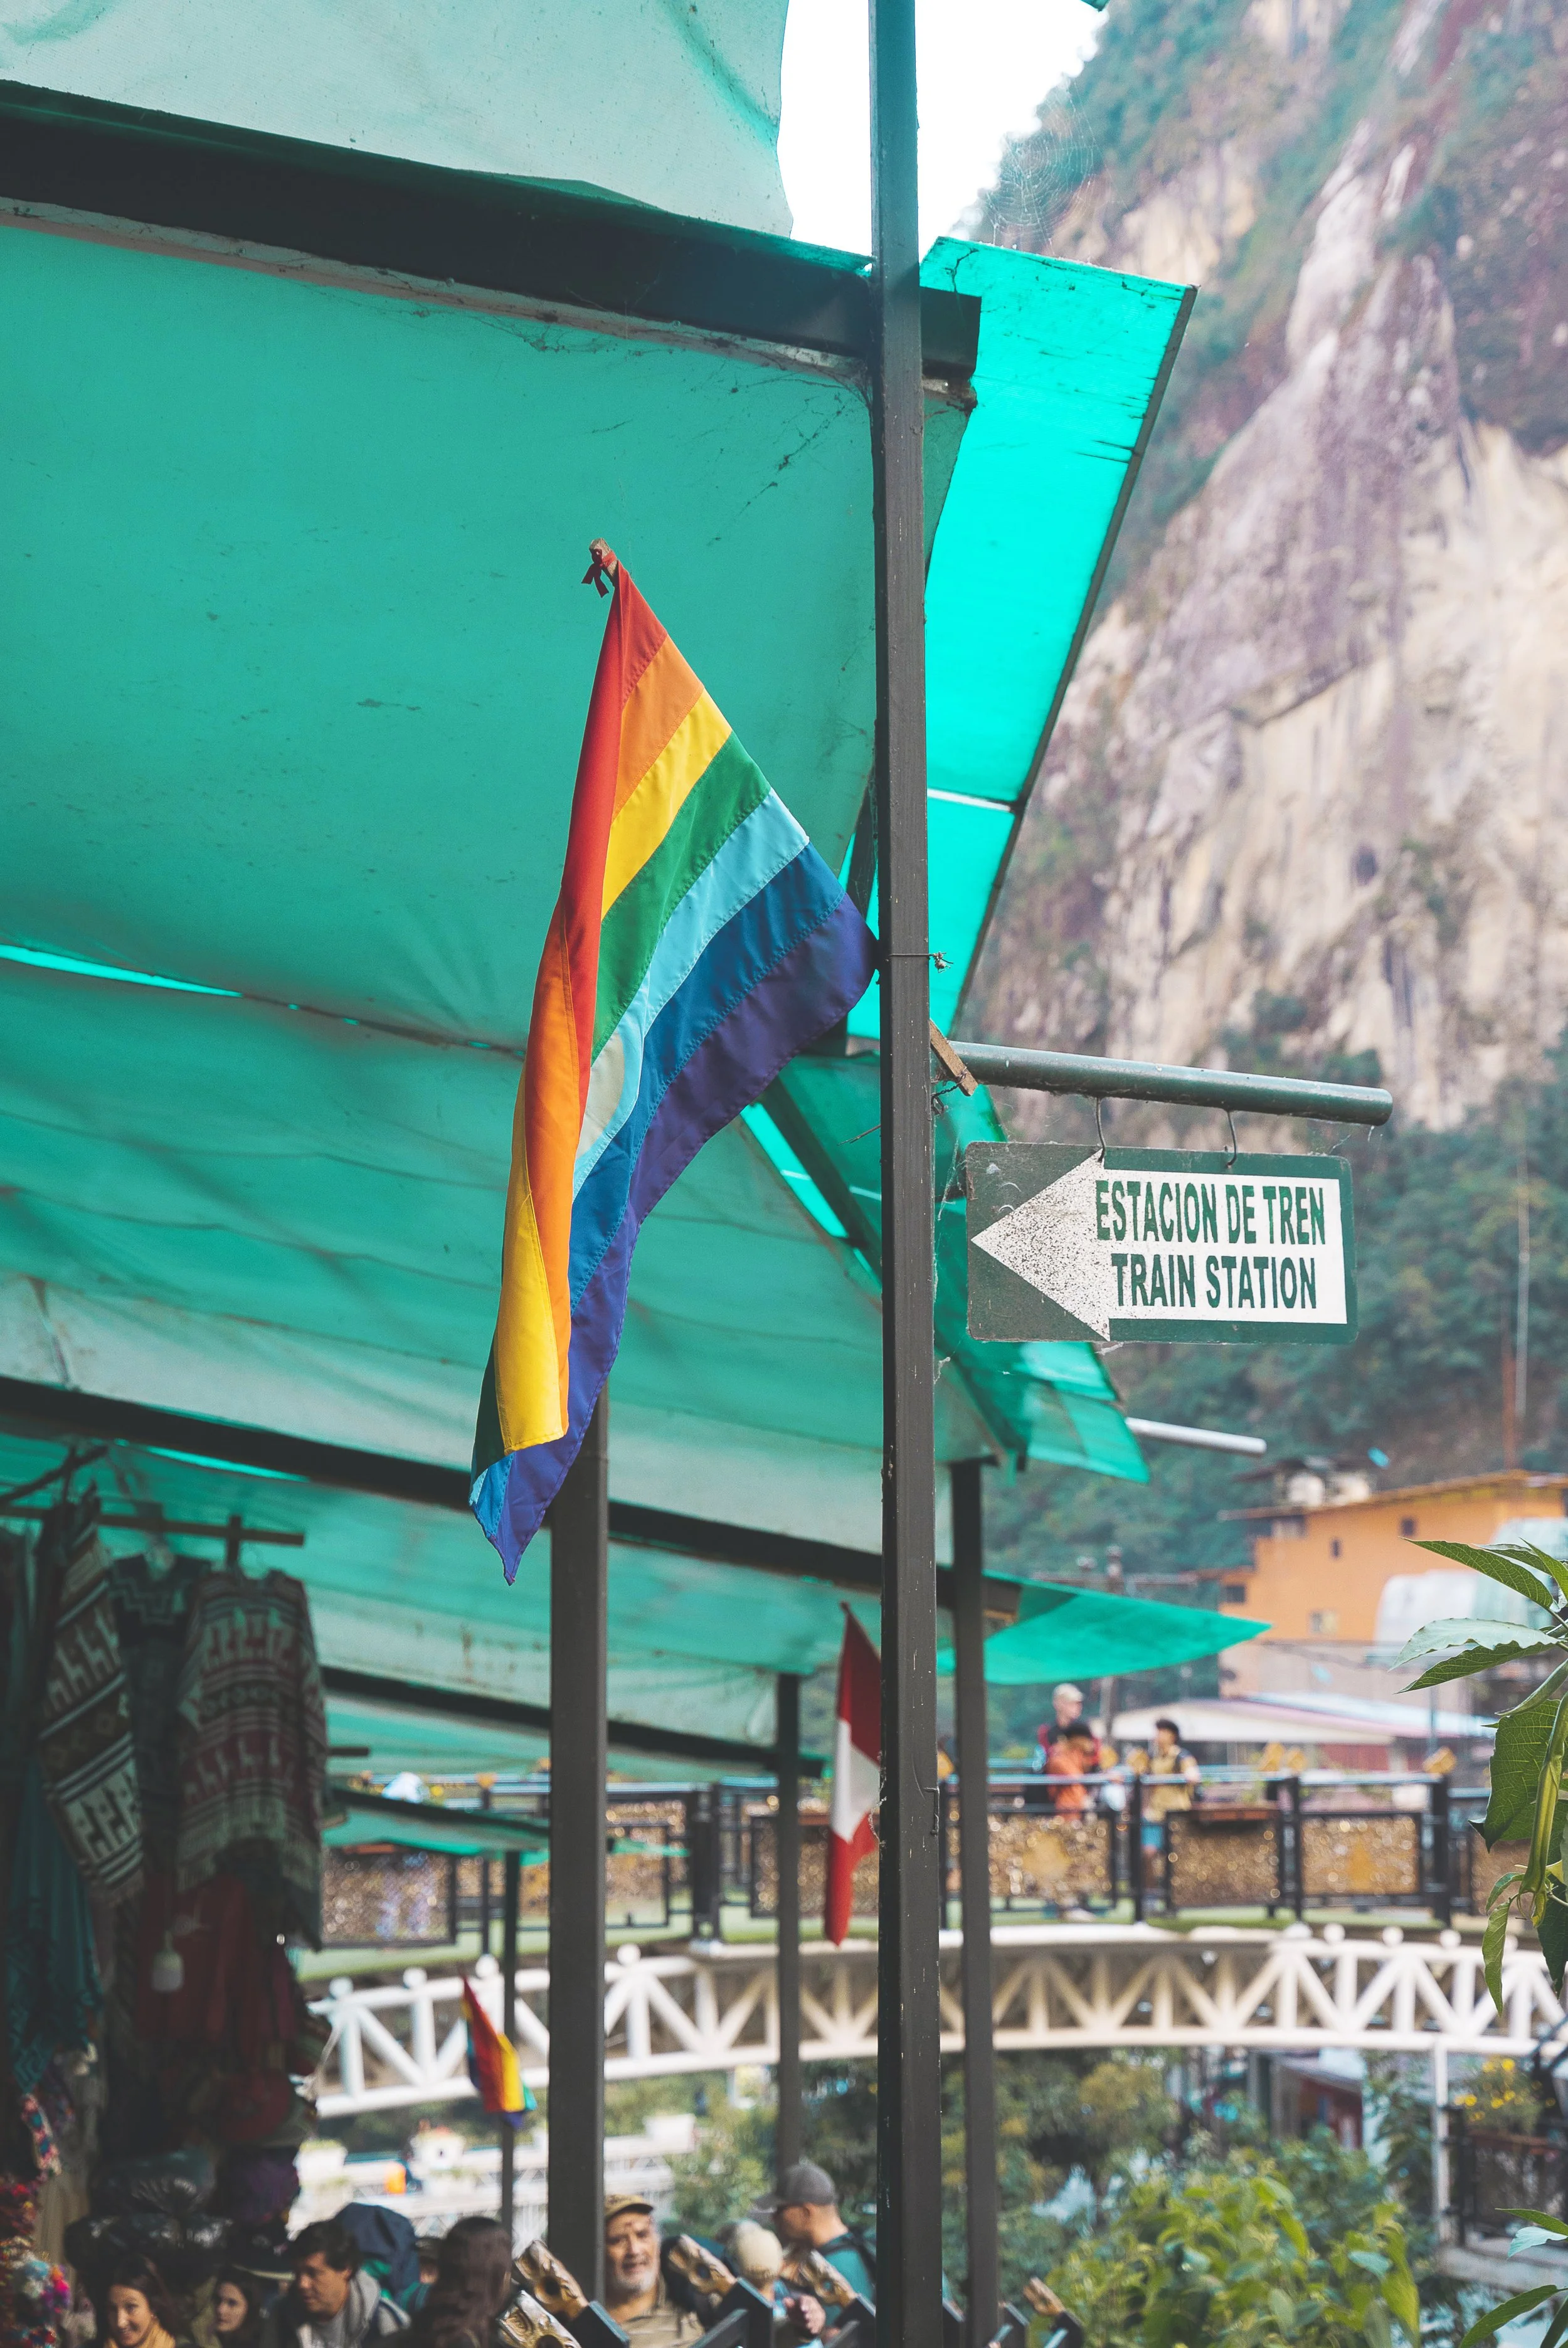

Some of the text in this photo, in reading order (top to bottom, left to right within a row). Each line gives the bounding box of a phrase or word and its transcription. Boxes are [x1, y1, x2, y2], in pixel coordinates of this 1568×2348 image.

[1095, 1180, 1326, 1245] ESTACION DE TREN
[1111, 1253, 1317, 1309] TRAIN STATION
